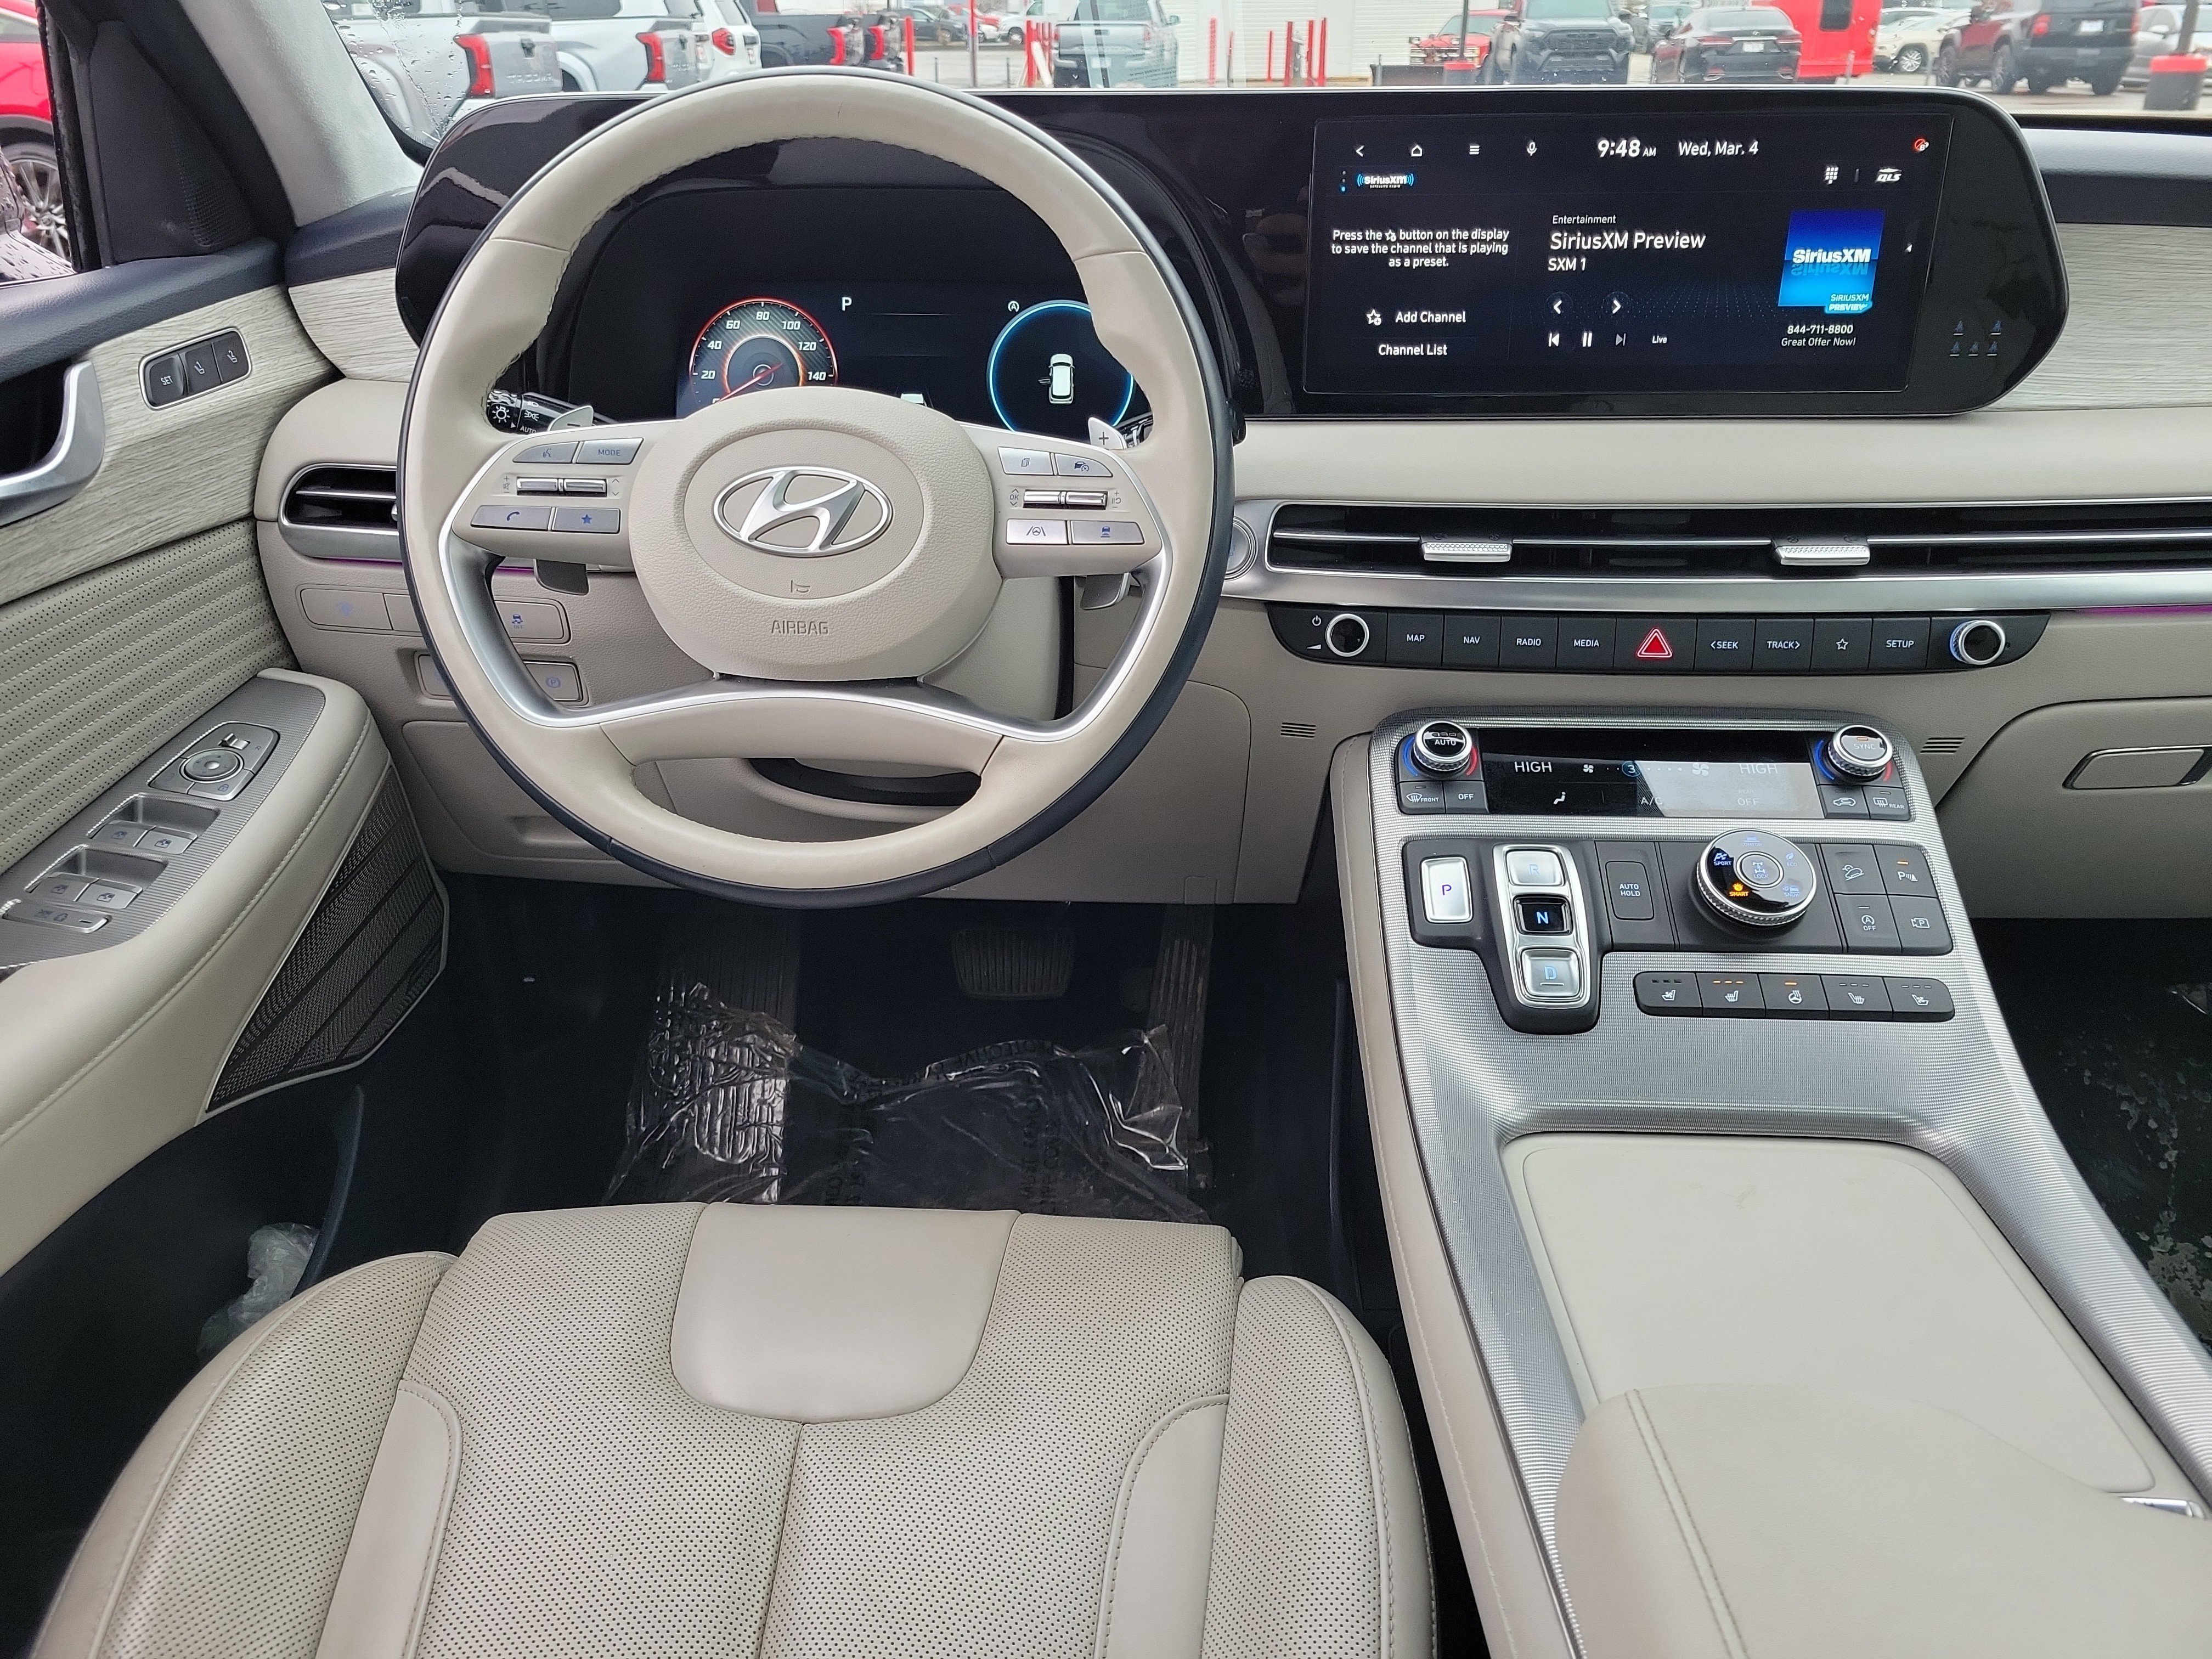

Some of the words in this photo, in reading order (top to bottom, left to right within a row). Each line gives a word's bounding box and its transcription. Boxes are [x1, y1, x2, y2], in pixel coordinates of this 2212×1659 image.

[1598, 140, 1641, 157] 9:48
[1643, 147, 1657, 157] AM
[1678, 142, 1711, 157] Wed,
[1715, 141, 1745, 155] Mar.
[1749, 140, 1759, 155] 4
[1364, 176, 1407, 184] SiriusXM
[1552, 215, 1617, 224] Entertainment
[1333, 229, 1363, 241] Press
[1365, 229, 1383, 240] the
[1399, 229, 1433, 240] button
[1436, 232, 1449, 240] on
[1452, 229, 1469, 240] the
[1471, 228, 1509, 241] display
[1550, 232, 1629, 249] SiriusXM
[1633, 232, 1706, 249] Preview
[1331, 244, 1342, 254] to
[1344, 245, 1369, 254] save
[1371, 243, 1388, 253] the
[1390, 243, 1432, 253] channel
[1435, 242, 1456, 253] that
[1458, 243, 1468, 253] is
[1470, 242, 1508, 255] playing
[1793, 249, 1871, 263] SiriusXM
[1389, 258, 1401, 267] as
[1403, 258, 1410, 267] a
[1413, 257, 1449, 269] preset.
[1548, 258, 1577, 271] SXM
[1581, 258, 1587, 270] 1
[841, 297, 852, 311] P
[756, 312, 770, 320] 80
[1395, 312, 1417, 323] Add
[1420, 312, 1466, 323] Channel
[725, 320, 741, 329] 60
[782, 321, 801, 330] 100
[1787, 325, 1854, 334] 844-711-8800
[707, 341, 722, 349] 40
[798, 342, 817, 351] 120
[1781, 338, 1807, 346] Great
[1808, 337, 1831, 346] Offer
[1833, 337, 1856, 346] Now!
[1378, 345, 1424, 356] Channel
[1426, 345, 1448, 356] List
[701, 370, 715, 379] 20
[808, 371, 826, 381] 140
[160, 375, 173, 386] SET
[771, 620, 829, 635] AIRBAG
[1407, 634, 1425, 642] MAP
[1463, 636, 1480, 645] NAV
[1516, 638, 1542, 646] RADIO
[1886, 640, 1914, 648] SETUP
[1514, 761, 1552, 772] HIGH
[1628, 764, 1635, 774] 3
[1739, 763, 1778, 774] HIGH
[1640, 797, 1663, 805] A/C
[1528, 864, 1540, 876] R
[1441, 884, 1452, 895] P
[1536, 911, 1549, 924] N
[1544, 966, 1557, 980] D
